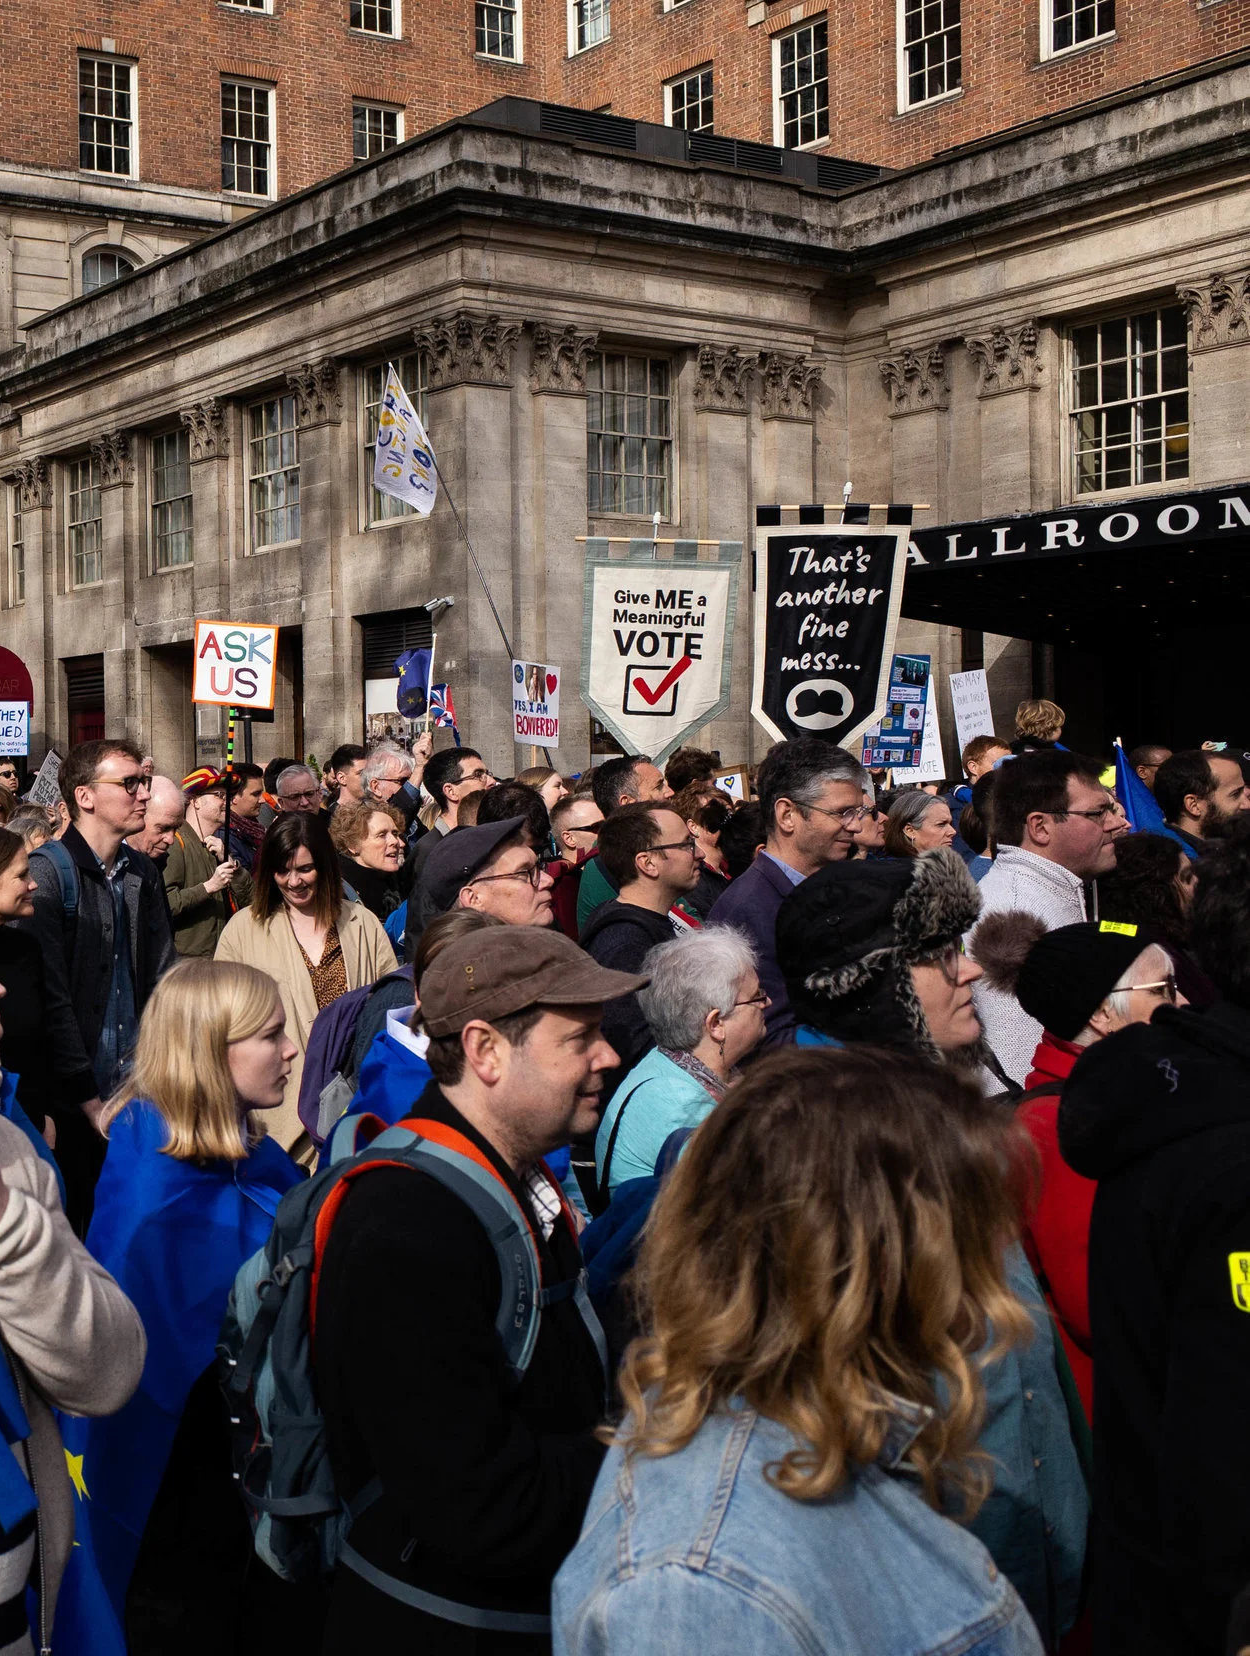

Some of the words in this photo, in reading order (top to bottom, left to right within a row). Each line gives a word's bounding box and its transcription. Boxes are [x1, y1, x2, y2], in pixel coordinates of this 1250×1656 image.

[905, 496, 1250, 566] ALLROOM
[788, 545, 871, 576] That's
[614, 589, 651, 605] Give
[654, 589, 694, 609] ME
[697, 595, 707, 607] a
[775, 578, 884, 608] another
[612, 608, 706, 629] Meaningful
[797, 612, 850, 646] fine
[199, 630, 272, 665] ASK
[613, 629, 704, 661] VOTE
[780, 651, 861, 672] mess...
[210, 666, 259, 699] US
[536, 703, 548, 715] AM
